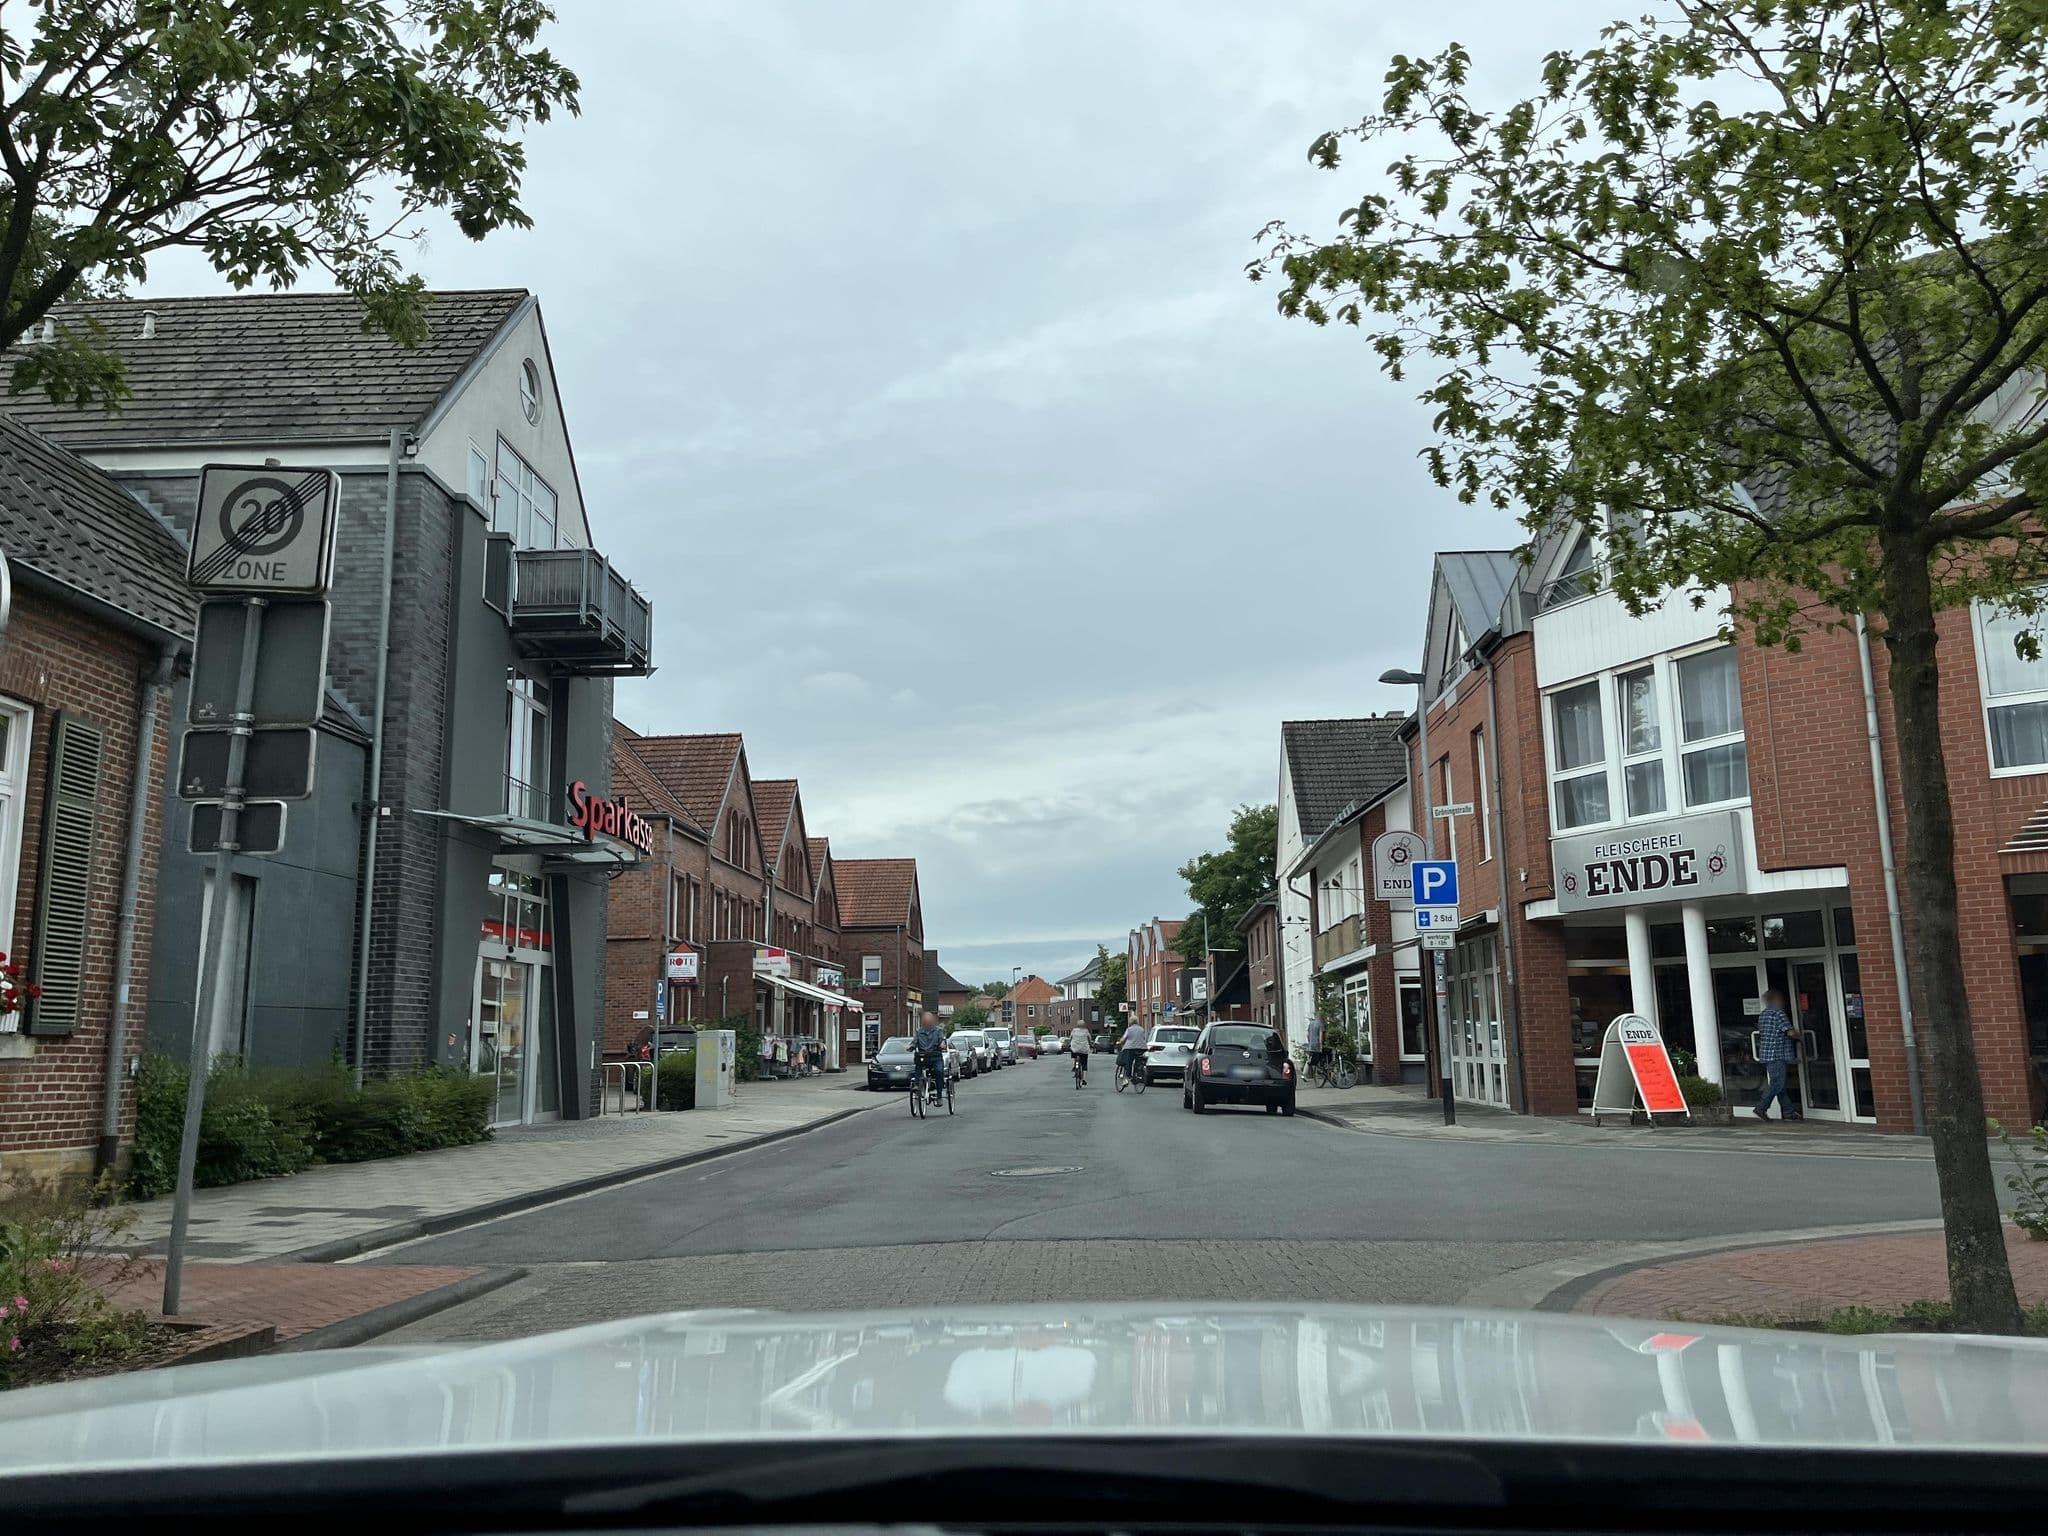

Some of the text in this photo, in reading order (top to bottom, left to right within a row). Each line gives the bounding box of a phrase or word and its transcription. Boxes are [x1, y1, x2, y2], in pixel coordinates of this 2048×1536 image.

[238, 498, 285, 534] 20
[222, 561, 287, 581] ZONE
[568, 781, 653, 856] Sparkasse
[1595, 833, 1682, 859] FLEISCHEREI
[1383, 879, 1412, 889] END
[1422, 867, 1447, 900] P
[1583, 848, 1699, 898] ENDE
[1434, 914, 1439, 922] 2
[657, 982, 663, 1000] P
[1625, 1030, 1653, 1039] ENDE
